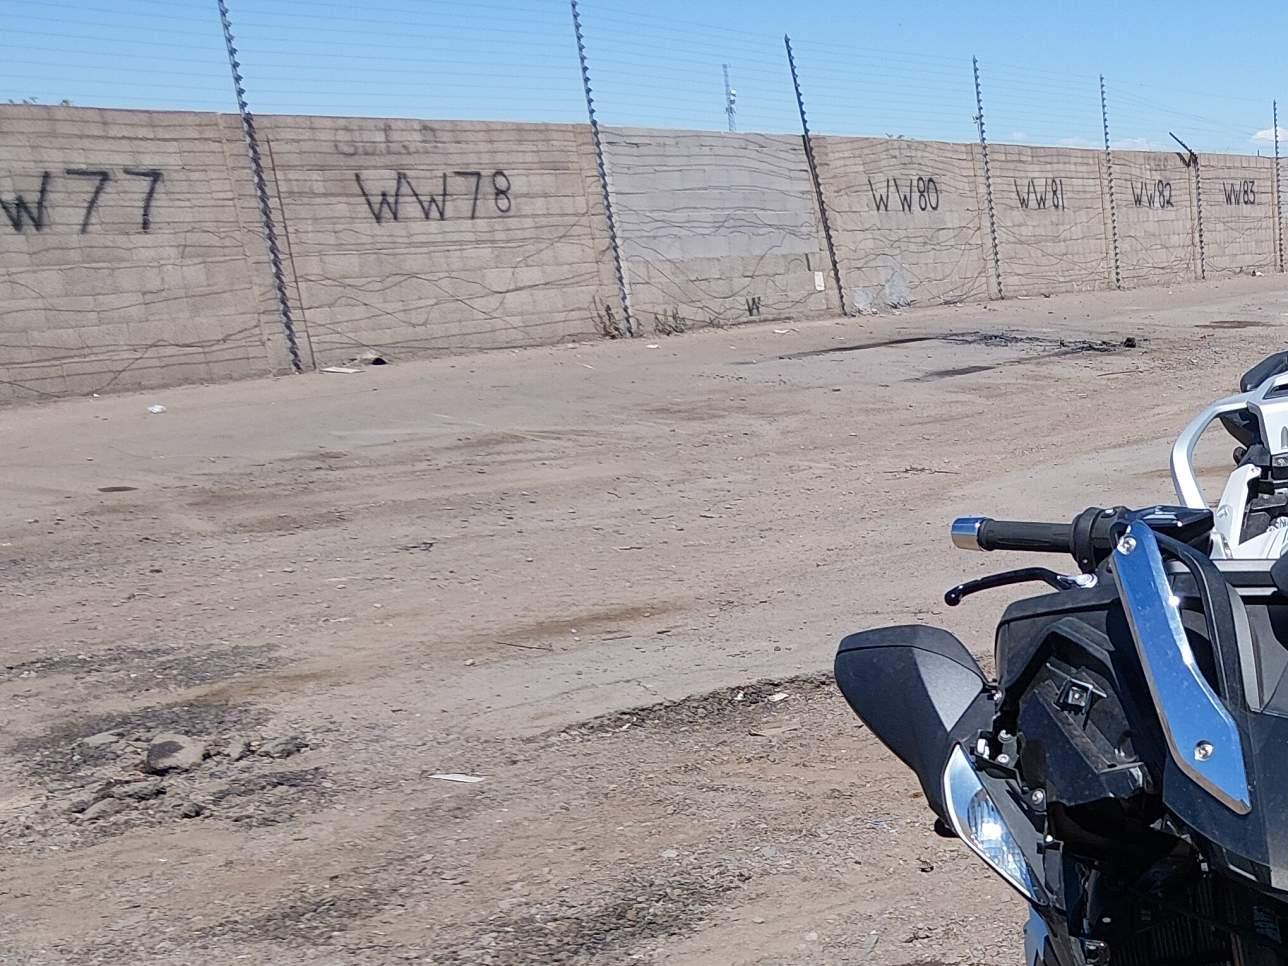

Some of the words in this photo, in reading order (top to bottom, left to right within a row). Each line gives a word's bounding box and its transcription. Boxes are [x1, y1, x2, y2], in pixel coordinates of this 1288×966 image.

[354, 168, 512, 226] WW78
[867, 176, 940, 213] WW80
[1013, 178, 1066, 212] WW81
[1130, 179, 1174, 209] WW82
[1222, 180, 1256, 206] WW83
